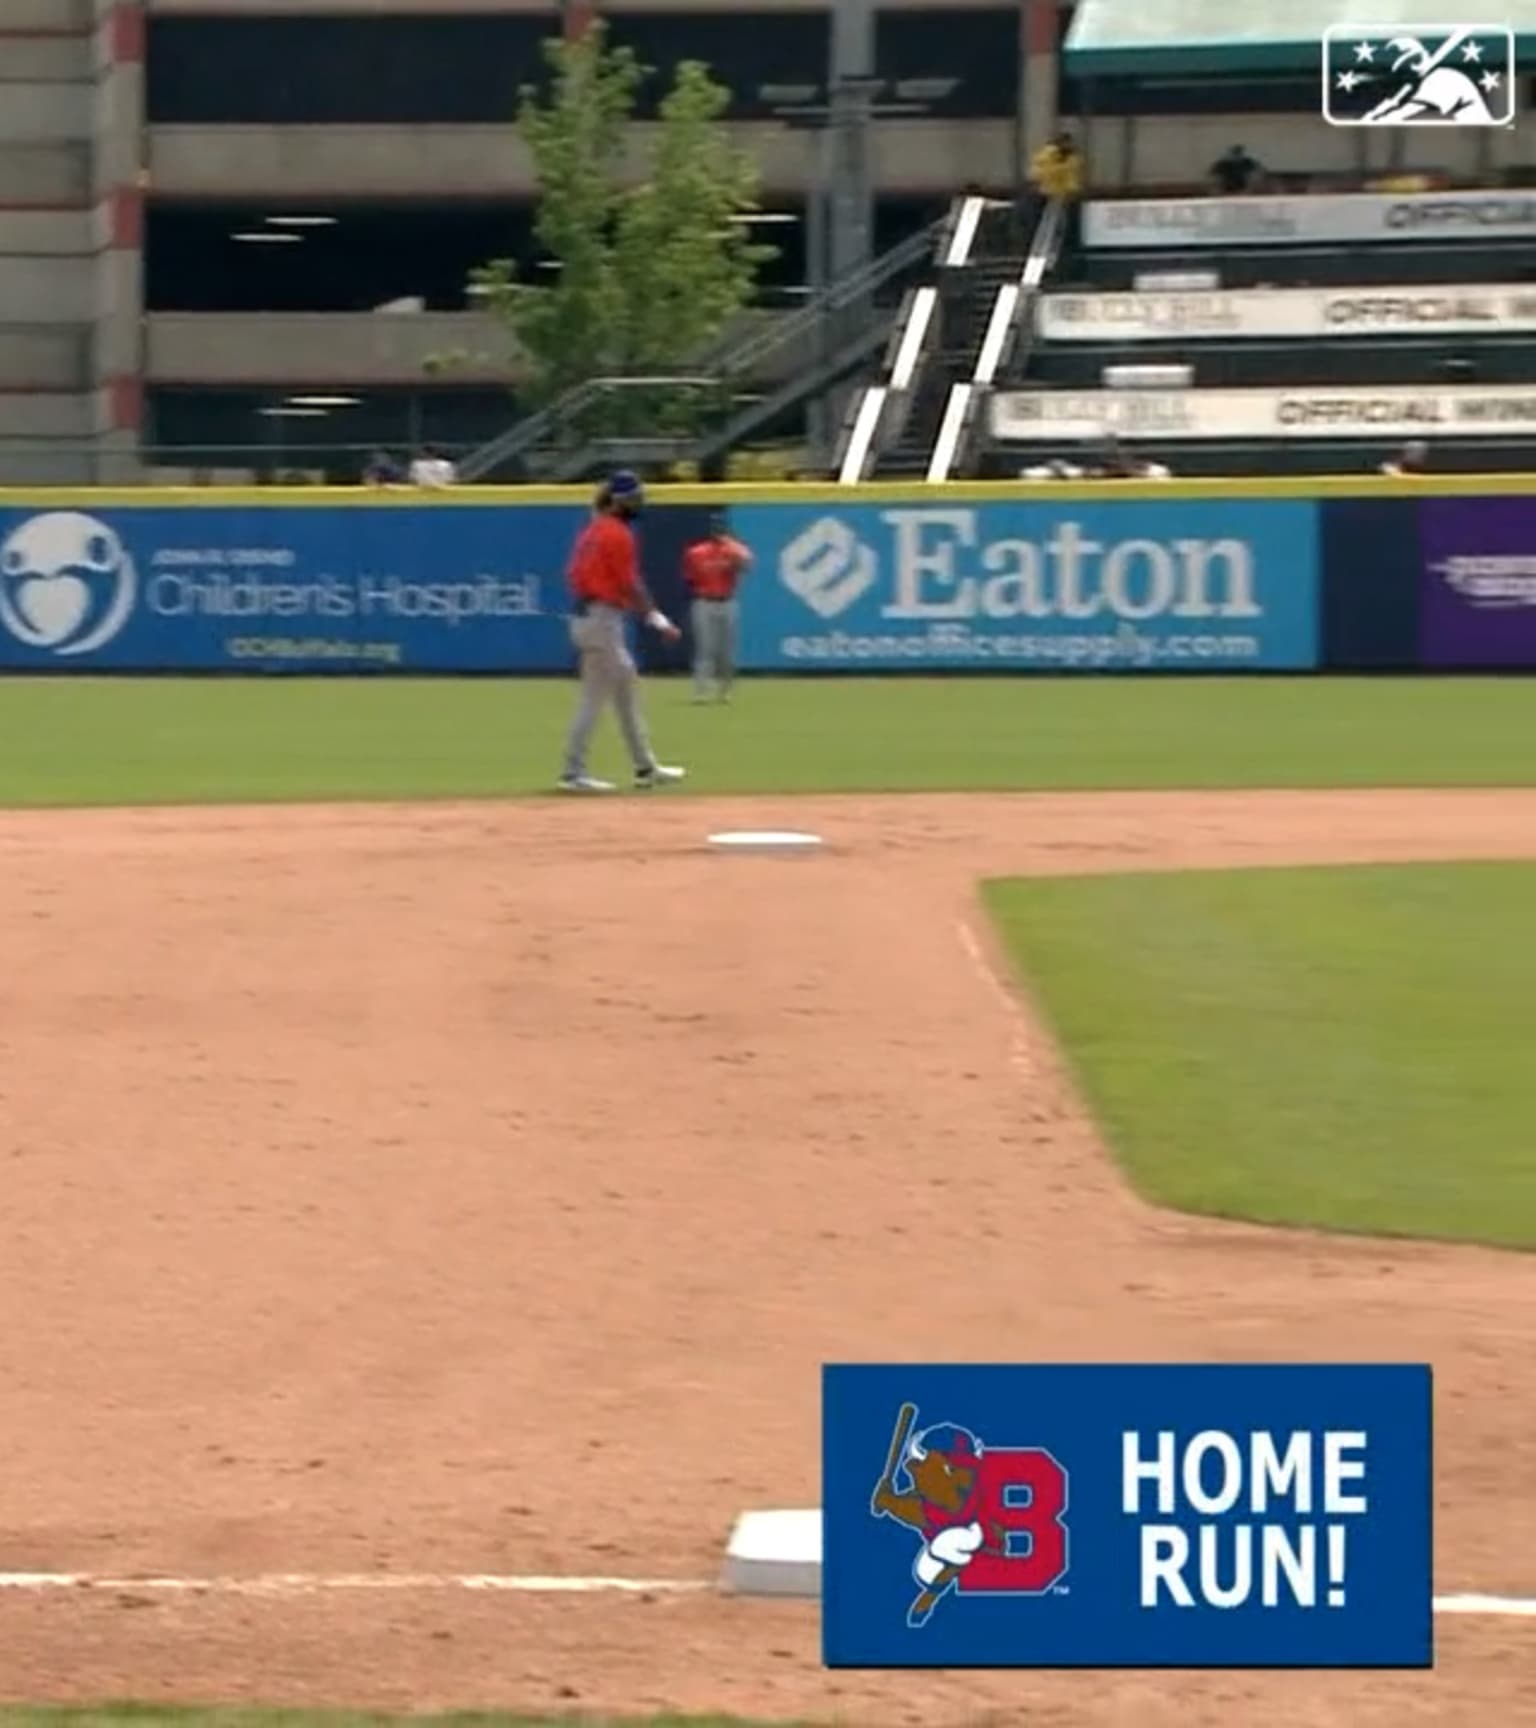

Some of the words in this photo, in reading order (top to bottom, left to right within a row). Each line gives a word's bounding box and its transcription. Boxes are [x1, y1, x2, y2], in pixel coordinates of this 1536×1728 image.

[1277, 398, 1445, 424] OFFICIAL
[881, 509, 1261, 619] Eaton
[147, 571, 354, 617] Children's
[359, 573, 540, 624] Hospital
[781, 624, 1259, 664] eatonofficesupply.com
